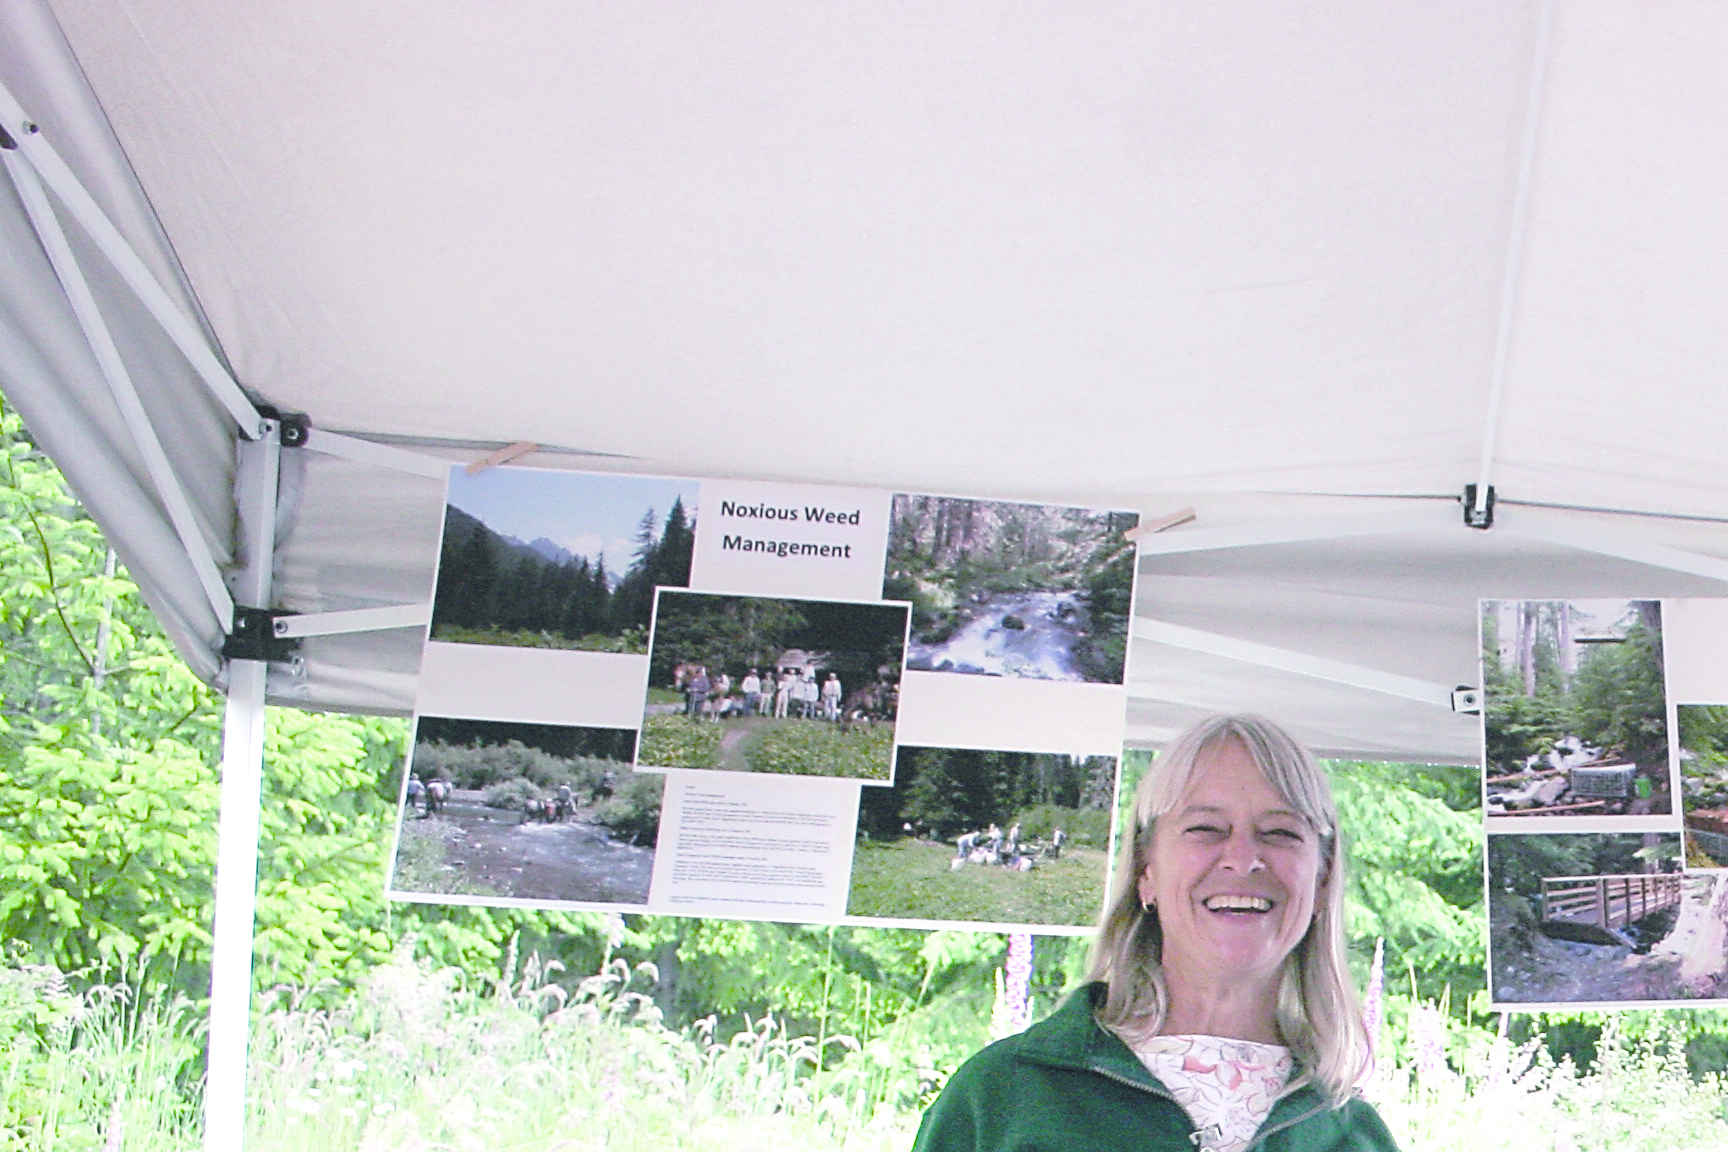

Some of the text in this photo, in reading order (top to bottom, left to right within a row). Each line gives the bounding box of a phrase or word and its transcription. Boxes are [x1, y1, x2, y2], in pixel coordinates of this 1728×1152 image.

[720, 500, 860, 525] Noxious Weed
[721, 534, 852, 559] Management
